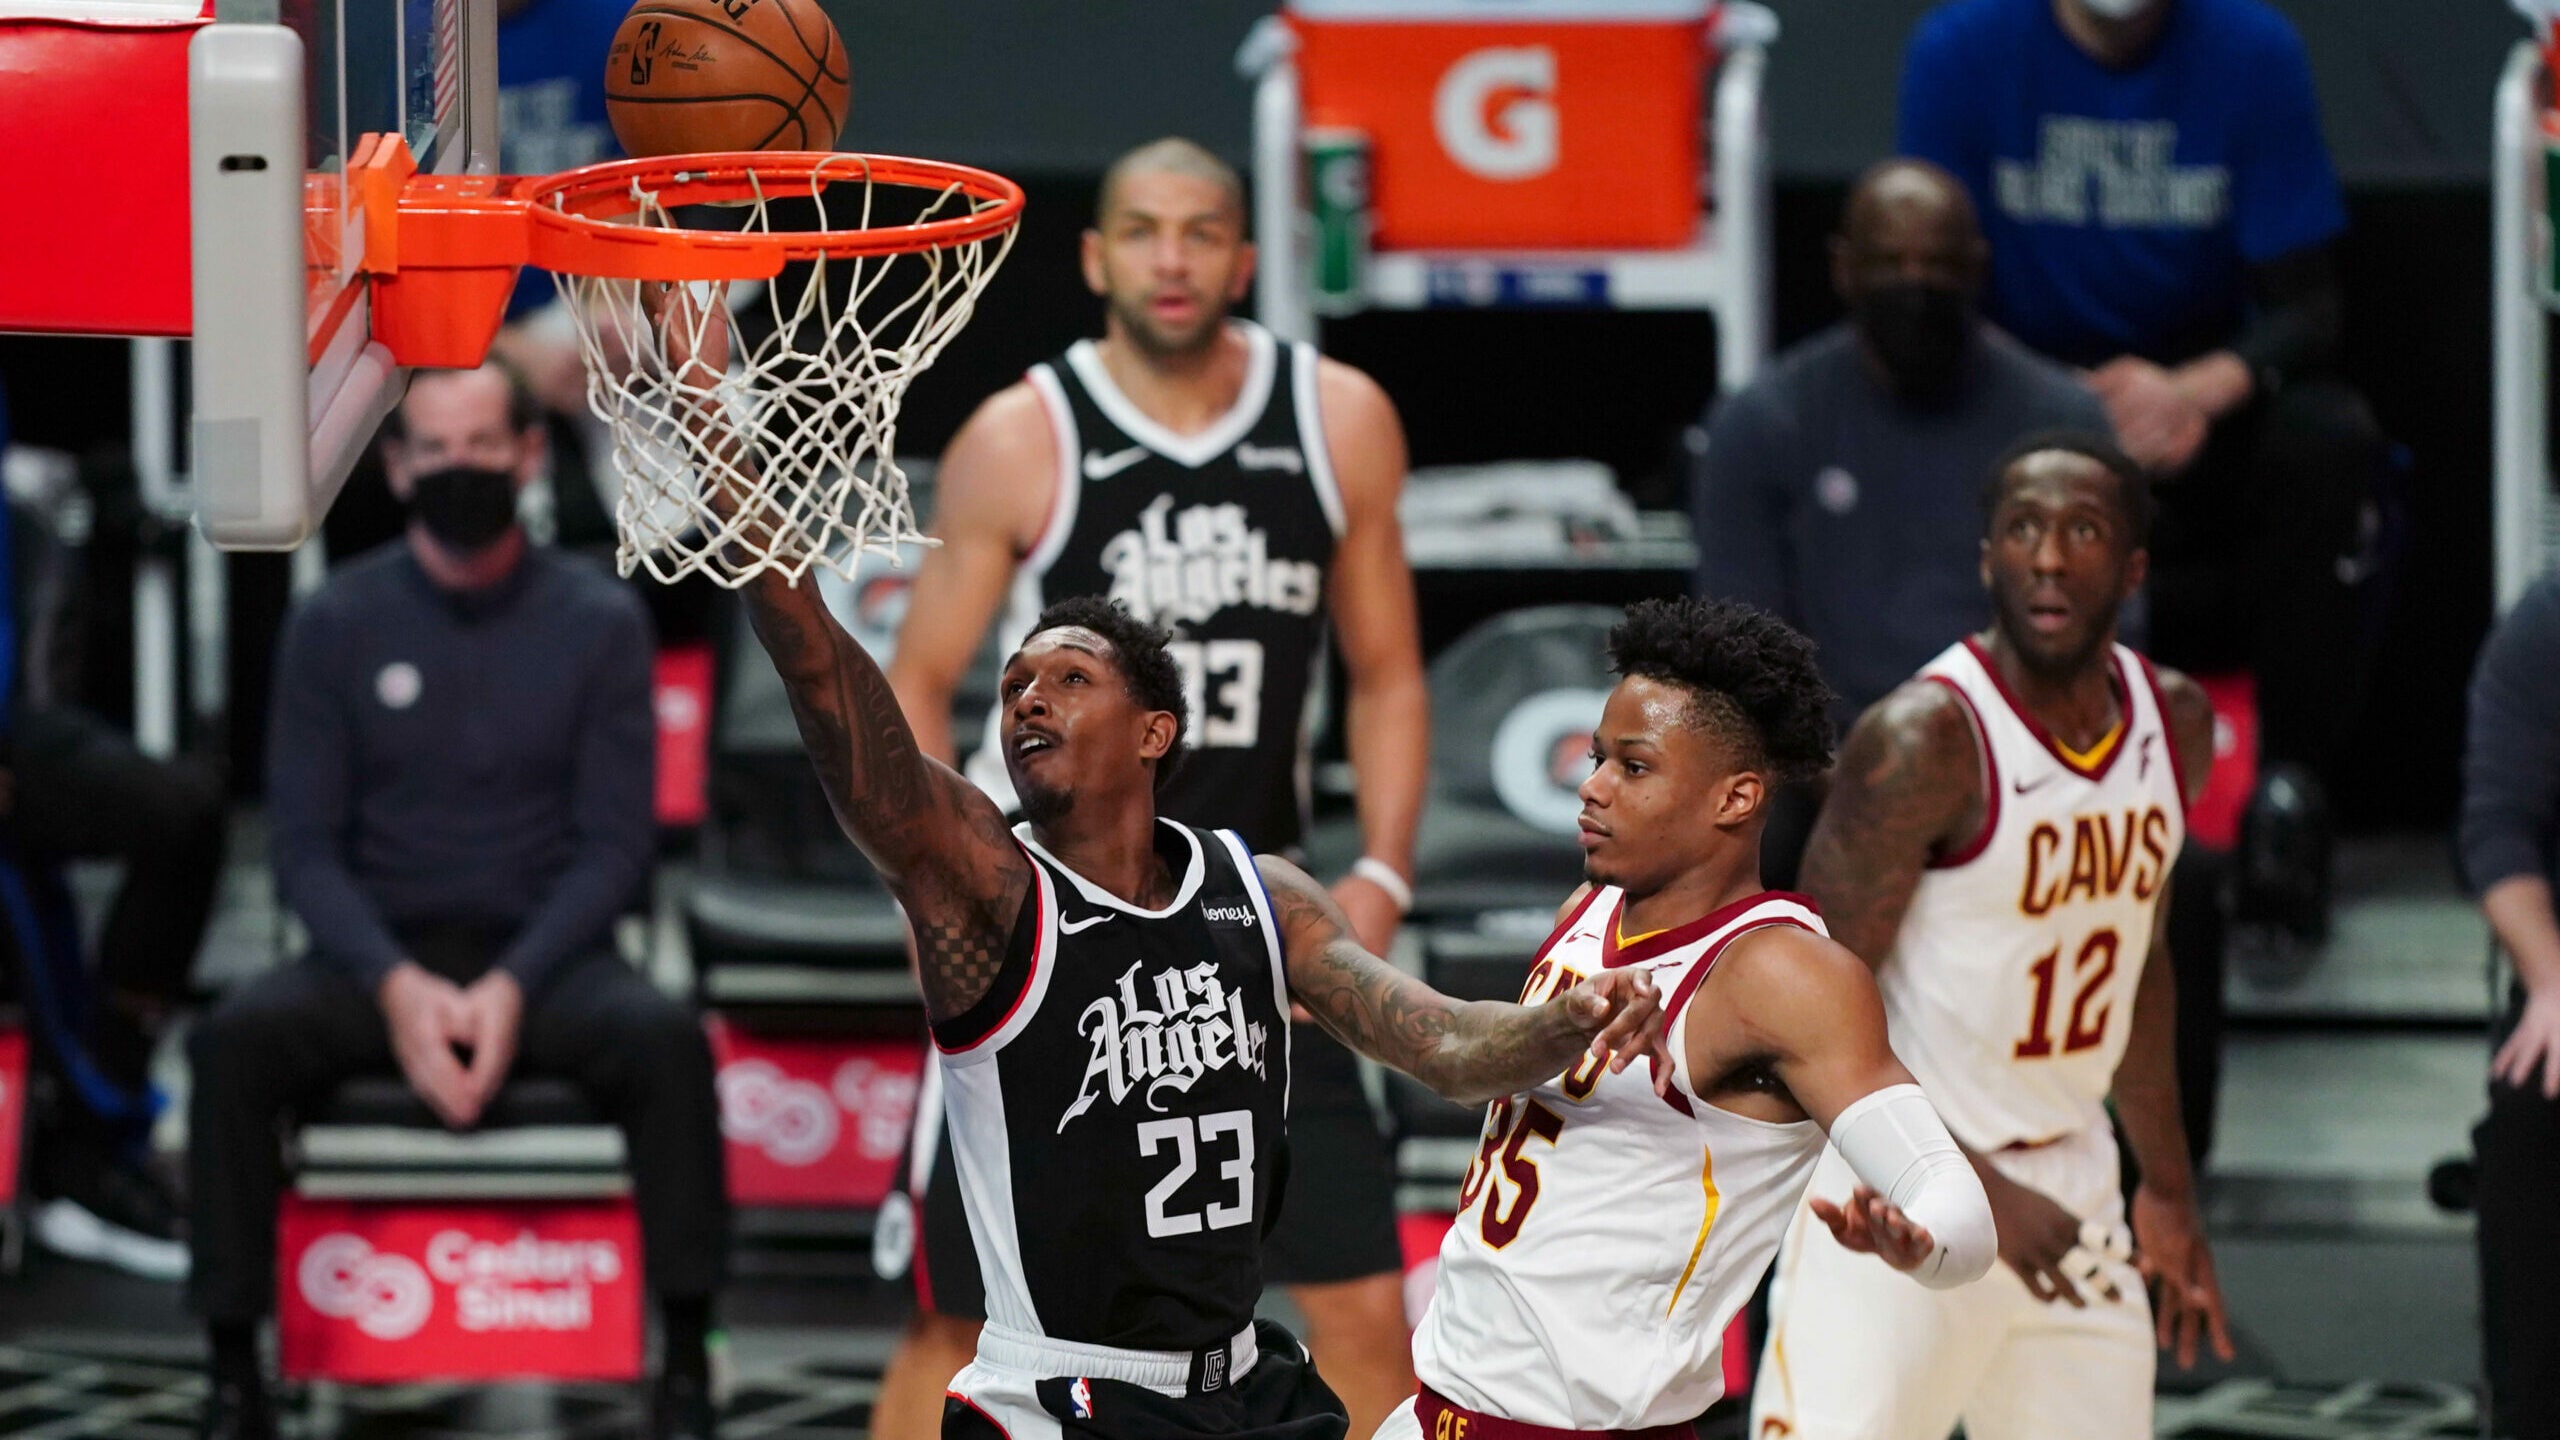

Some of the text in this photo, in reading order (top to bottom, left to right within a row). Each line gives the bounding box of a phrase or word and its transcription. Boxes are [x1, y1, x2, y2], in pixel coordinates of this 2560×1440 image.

[1432, 43, 1562, 181] G
[1138, 493, 1248, 556] Los
[2018, 806, 2169, 916] CAVS
[1115, 959, 1228, 1031] Los
[2013, 927, 2120, 1061] 12
[1056, 986, 1268, 1135] Angele
[1136, 1109, 1255, 1239] 23
[1457, 1095, 1566, 1252] 35
